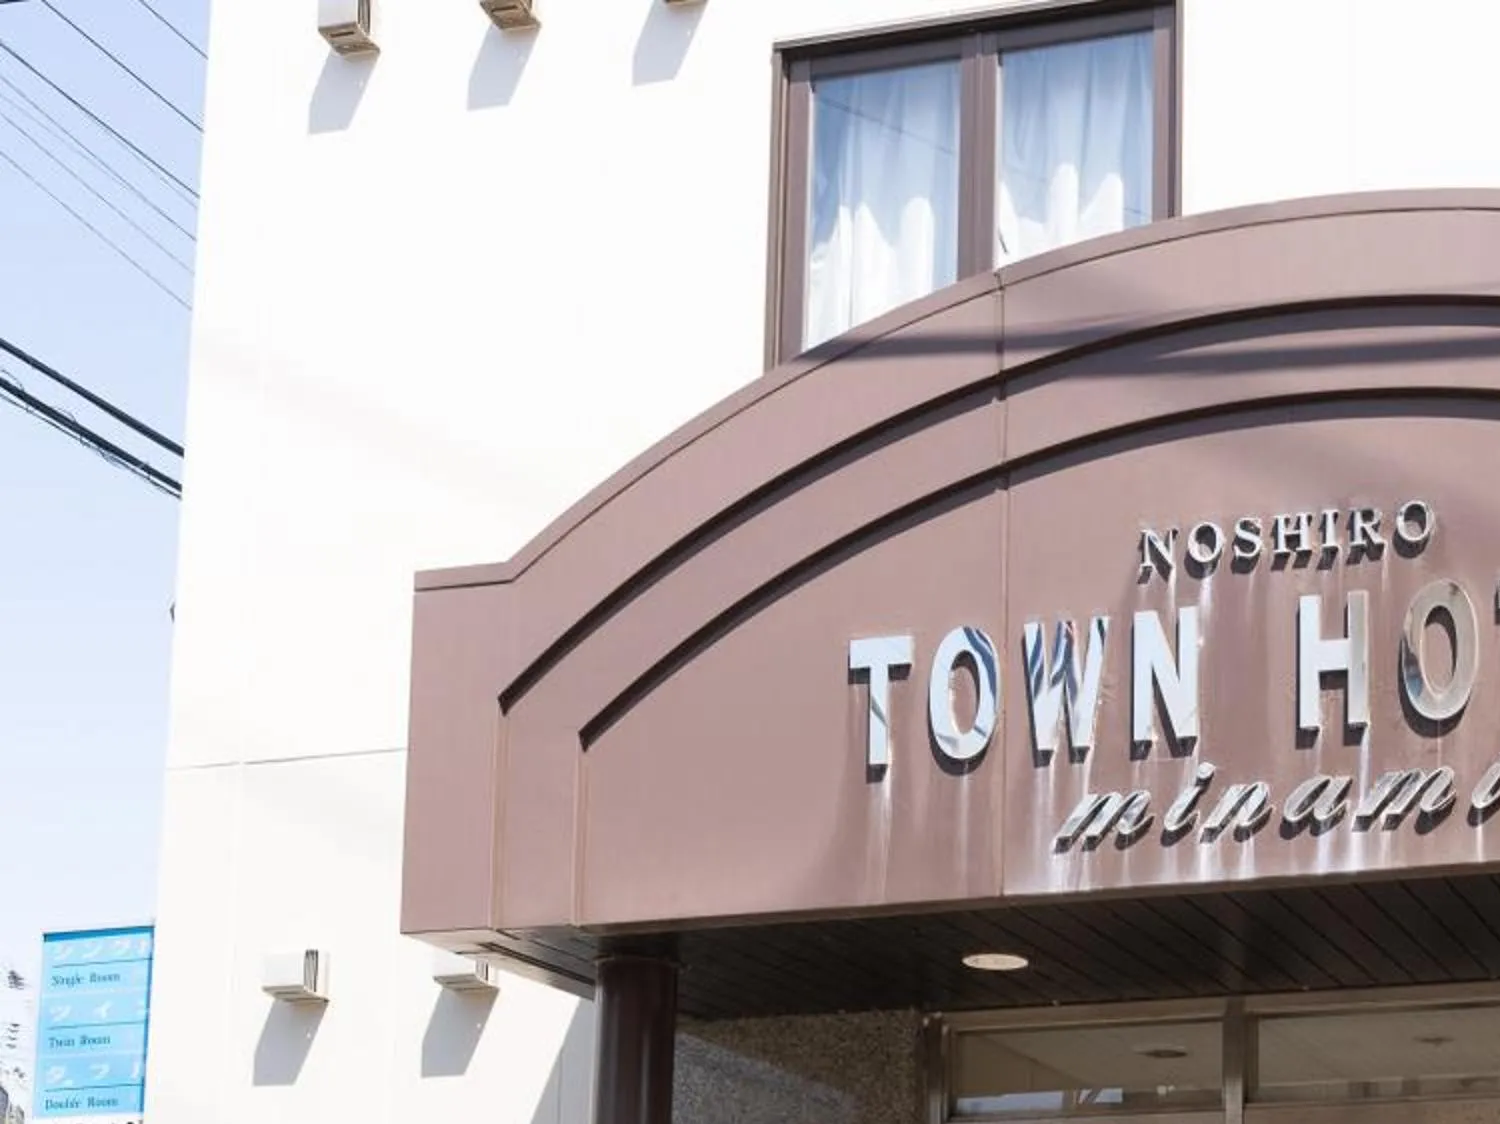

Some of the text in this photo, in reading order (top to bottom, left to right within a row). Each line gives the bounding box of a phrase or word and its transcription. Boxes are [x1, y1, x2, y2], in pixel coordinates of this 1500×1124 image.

[1138, 499, 1437, 572] NOSHIRO
[847, 605, 1202, 770] TOWN
[89, 972, 121, 984] Room
[79, 1034, 111, 1046] Room
[87, 1096, 119, 1108] Room
